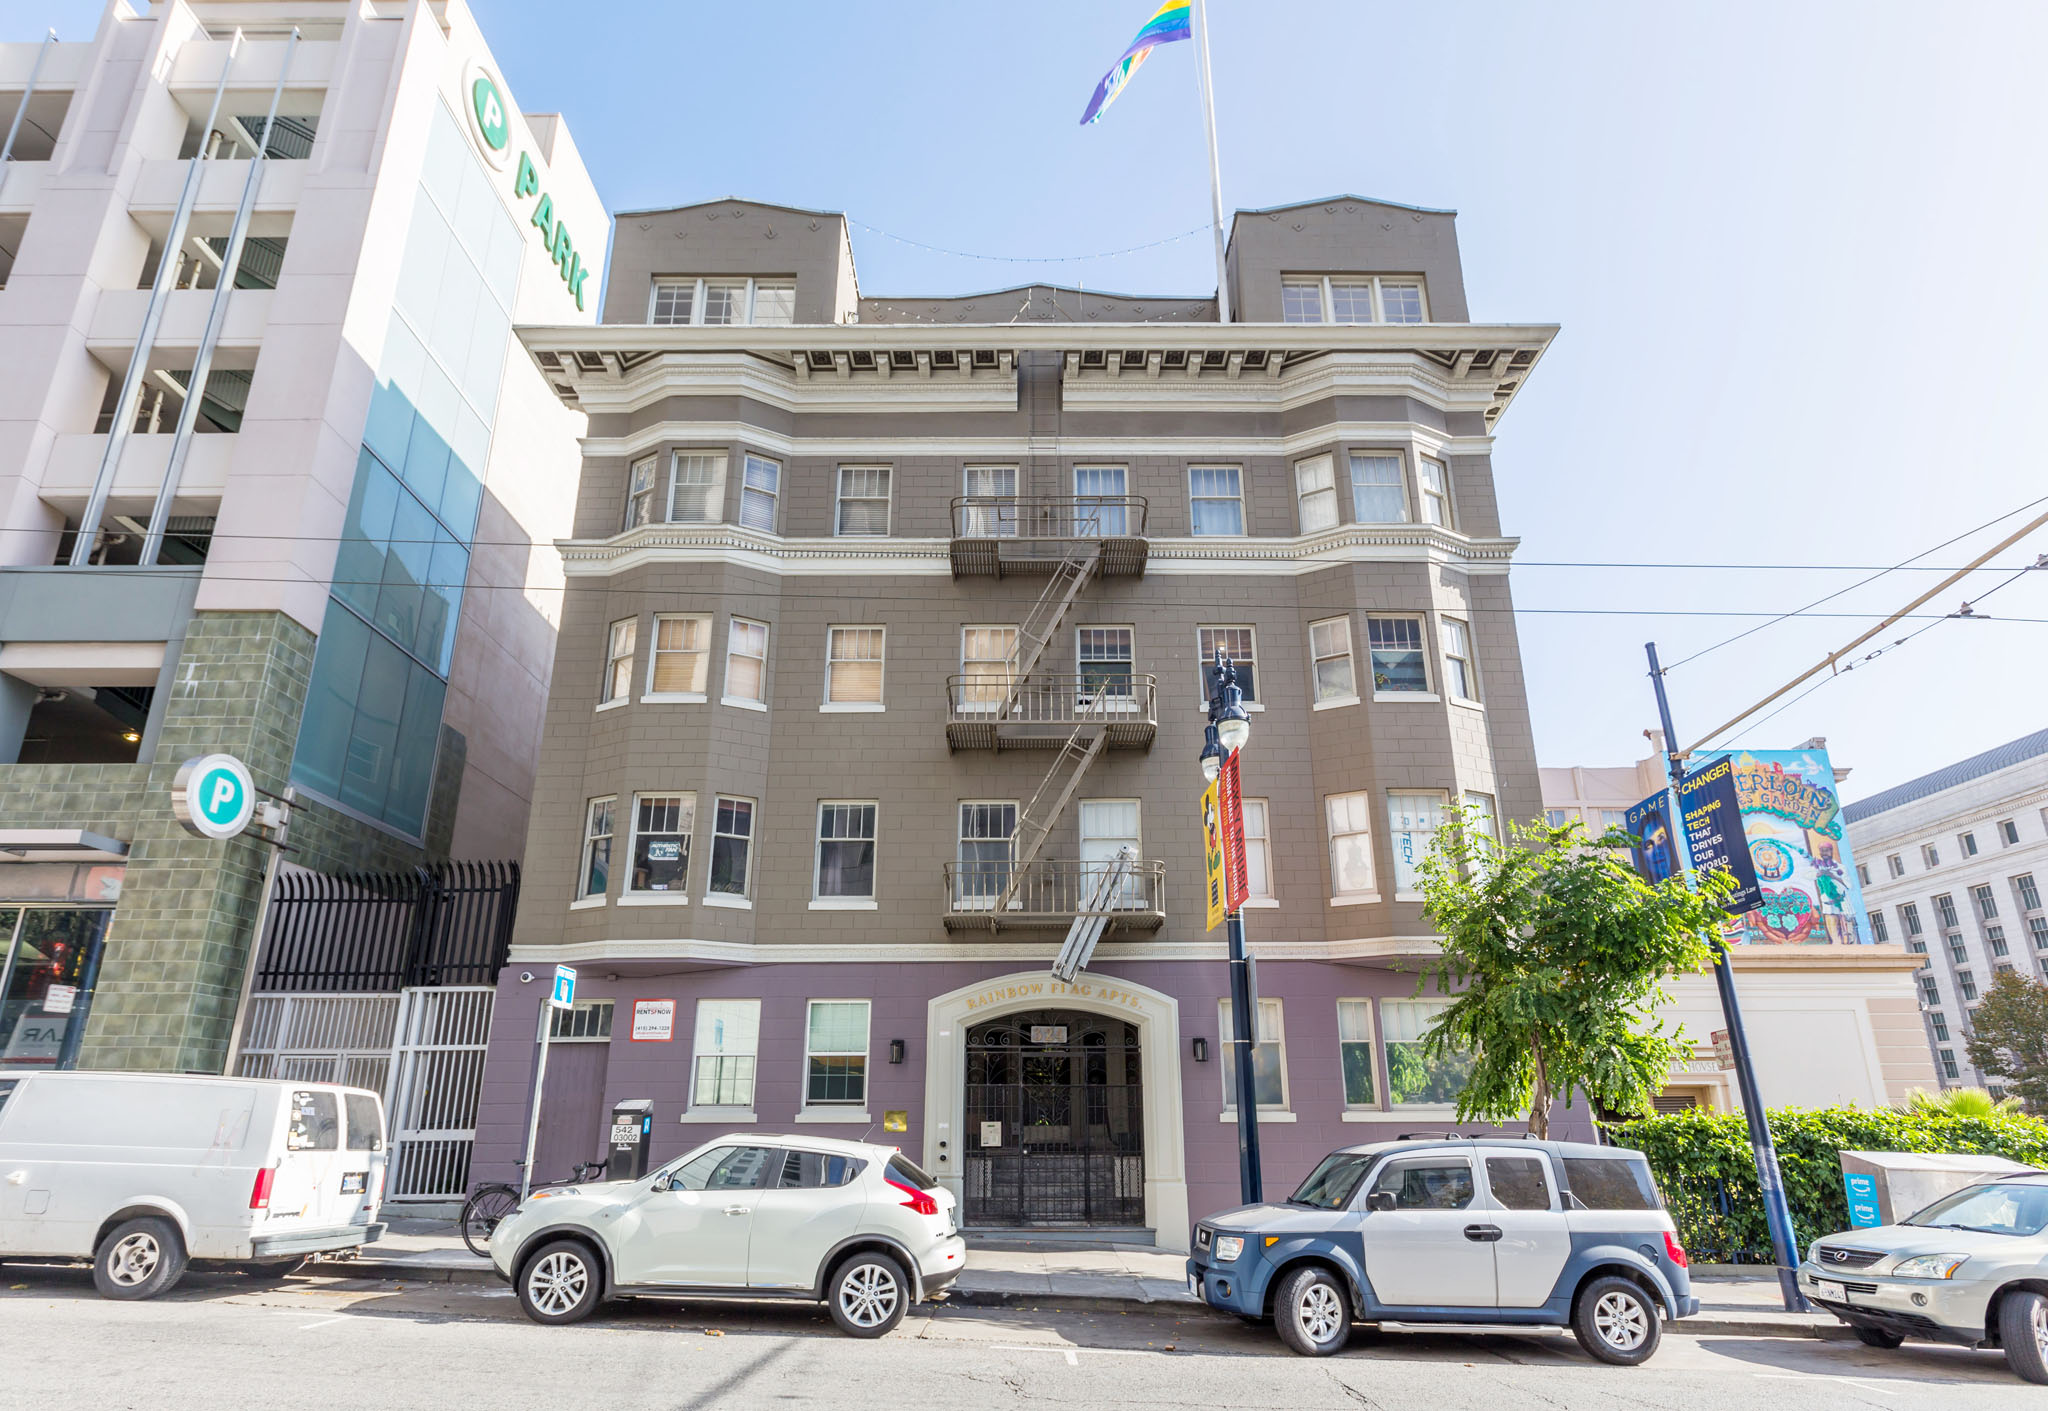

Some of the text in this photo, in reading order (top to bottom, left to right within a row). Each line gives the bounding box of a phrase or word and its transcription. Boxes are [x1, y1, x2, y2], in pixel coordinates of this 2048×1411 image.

[514, 150, 590, 312] PARK
[1681, 762, 1730, 795] CHANGER
[209, 776, 235, 814] P
[1735, 774, 1826, 807] ERLOIN
[1629, 795, 1665, 823] GAME
[1685, 799, 1721, 821] SHAPING
[1761, 793, 1820, 820] GARDEN
[1230, 756, 1246, 891] MICKEY MOUSE
[1687, 816, 1711, 831] TECH
[1689, 827, 1712, 842] THAT
[1691, 834, 1723, 852] DRIVES
[1694, 850, 1715, 862] OUR
[1696, 855, 1729, 874] WORLD
[966, 983, 1143, 1009] RAINBOW FLAG APTS.
[1033, 1028, 1063, 1041] 324
[613, 1133, 638, 1141] 03002
[615, 1126, 633, 1134] 542
[1850, 1177, 1869, 1186] prime
[1854, 1204, 1874, 1213] prime
